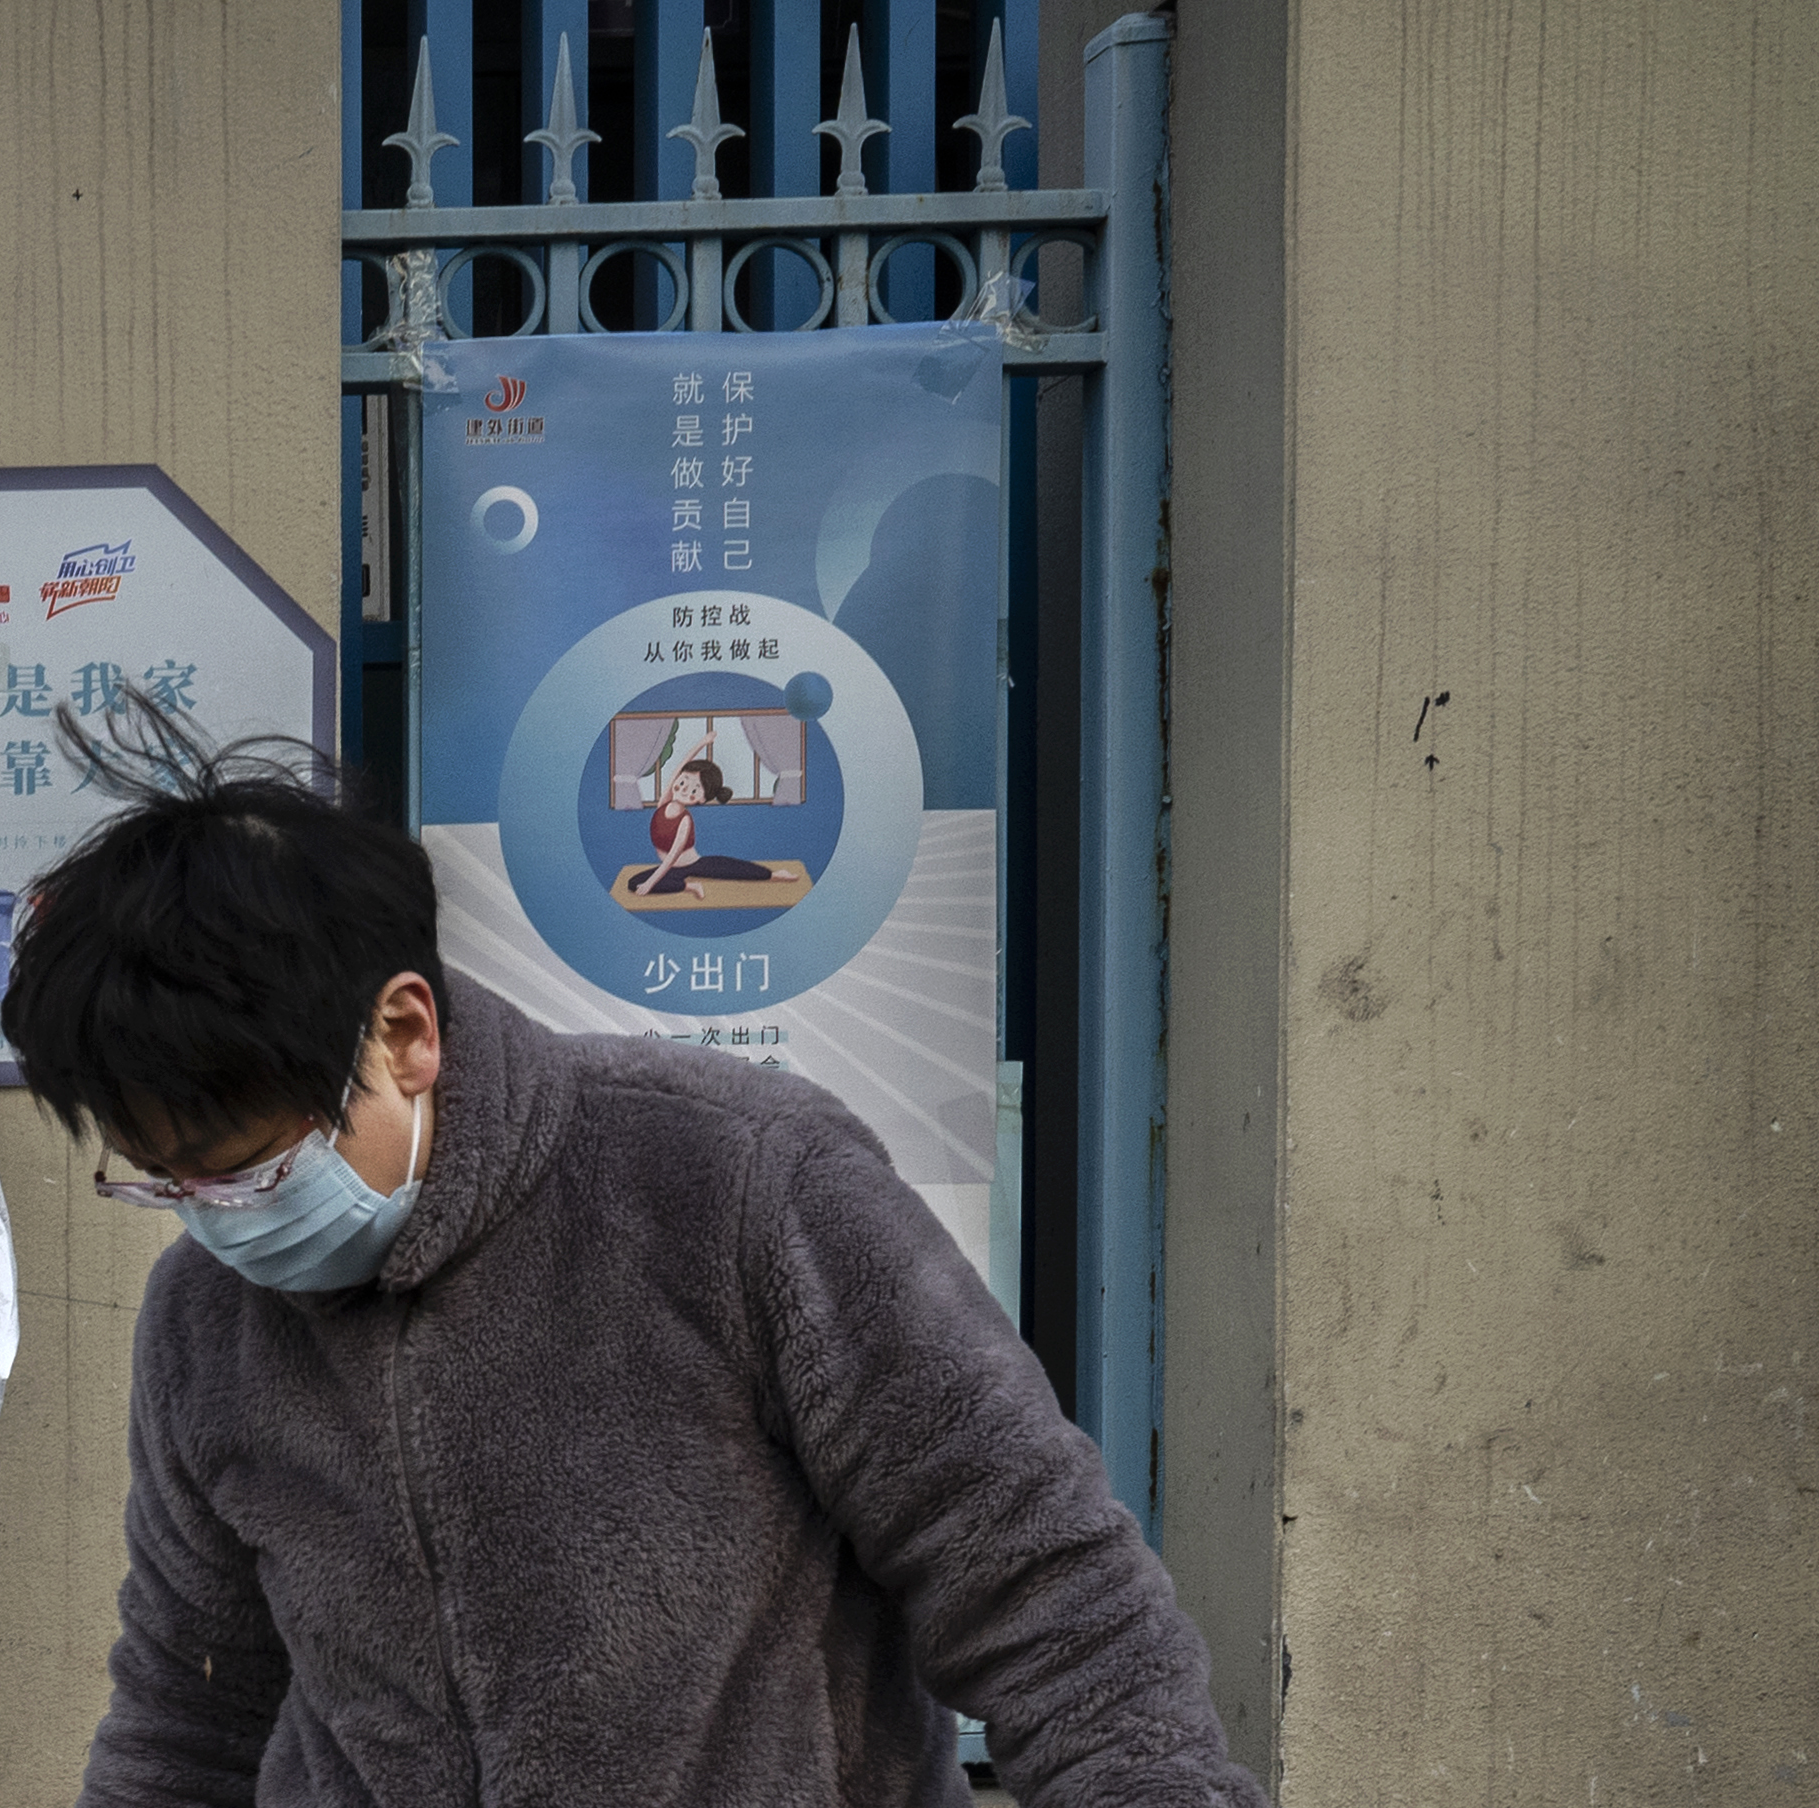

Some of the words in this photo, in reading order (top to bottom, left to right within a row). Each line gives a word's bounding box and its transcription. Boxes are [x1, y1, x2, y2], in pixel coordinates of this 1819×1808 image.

[670, 371, 705, 575] 就是做贡献
[720, 370, 755, 572] 保护好自己
[672, 603, 753, 629] 防控战
[643, 637, 781, 664] 从你我做起
[643, 952, 771, 996] 少出门
